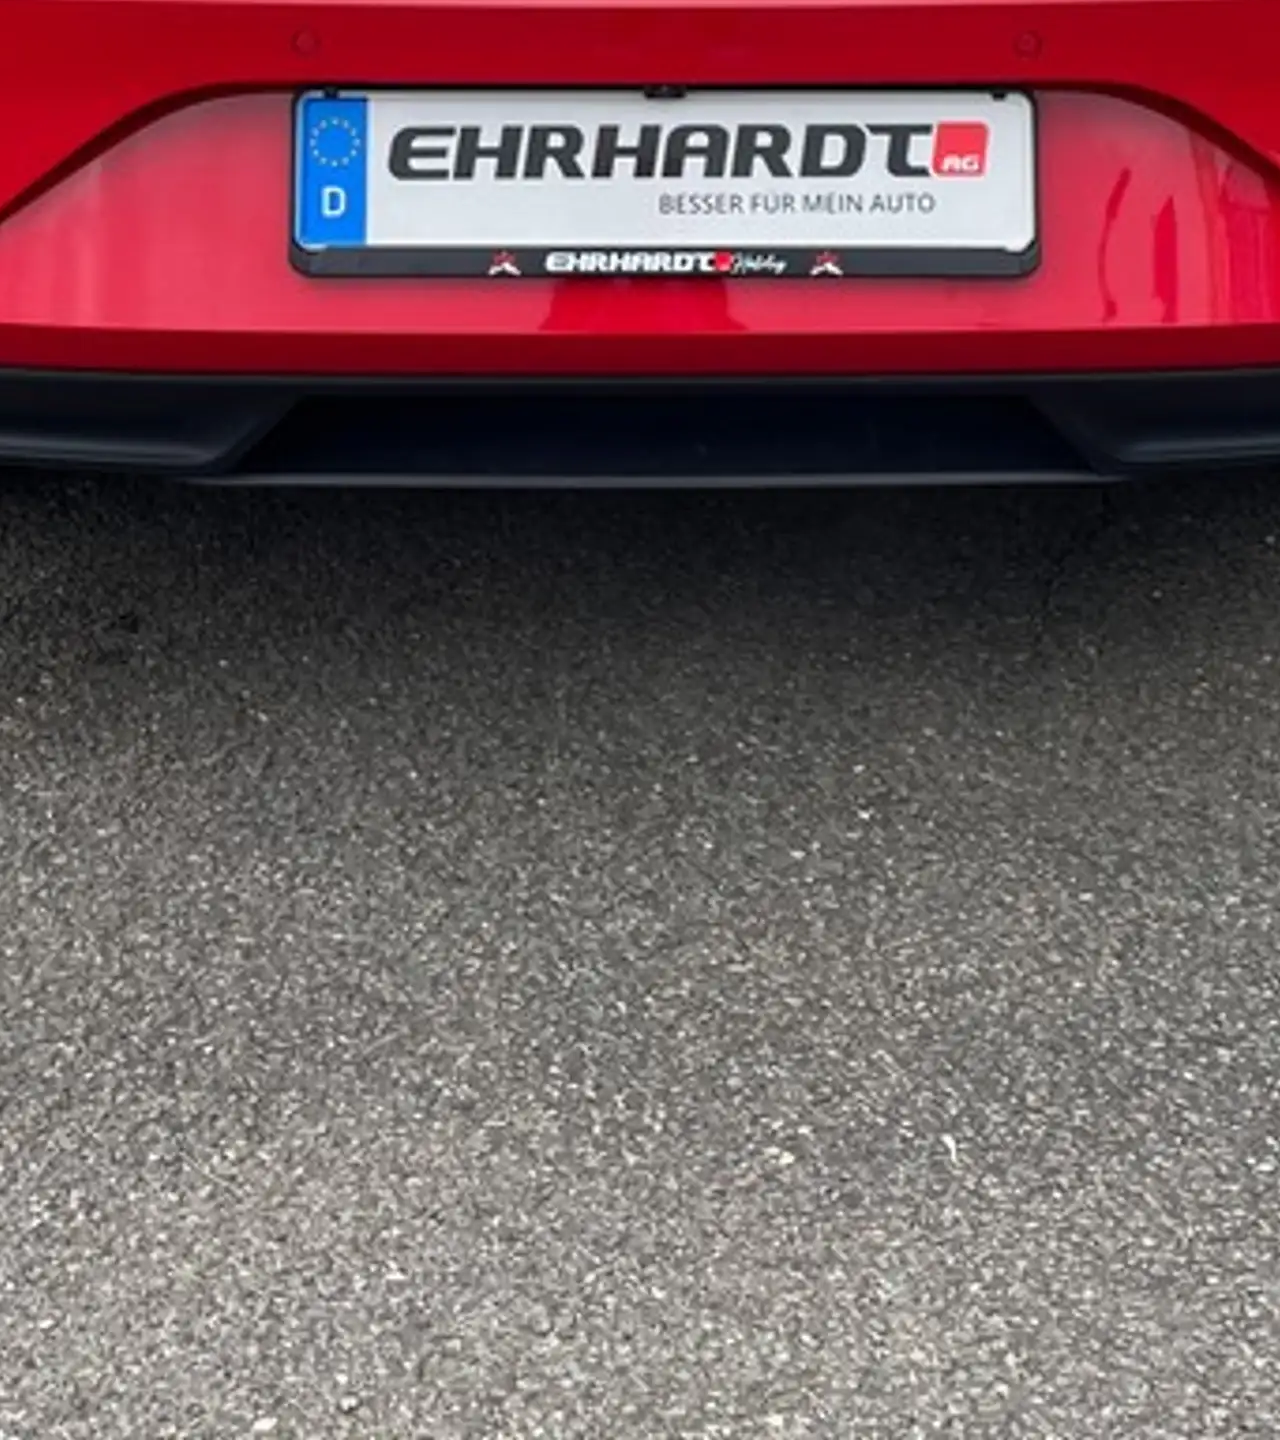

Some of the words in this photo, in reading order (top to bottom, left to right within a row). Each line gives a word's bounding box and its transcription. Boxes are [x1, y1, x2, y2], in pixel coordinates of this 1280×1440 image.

[389, 123, 933, 181] EHRHARDT
[939, 153, 980, 173] AG
[322, 186, 347, 218] D
[658, 193, 744, 215] BESSER
[802, 193, 863, 213] MEIN
[870, 192, 936, 213] AUTO
[545, 251, 716, 273] EHRHARDT
